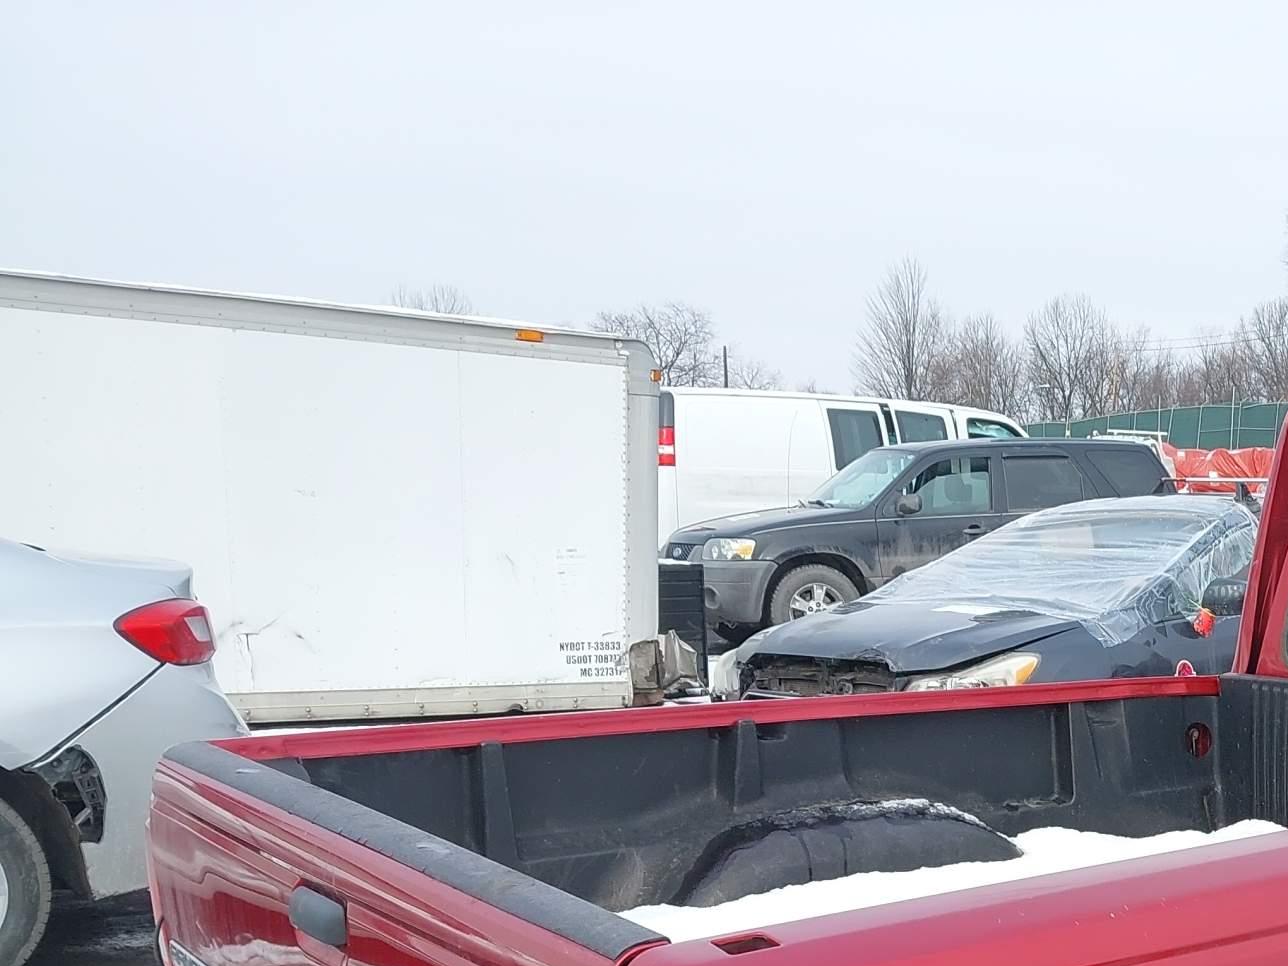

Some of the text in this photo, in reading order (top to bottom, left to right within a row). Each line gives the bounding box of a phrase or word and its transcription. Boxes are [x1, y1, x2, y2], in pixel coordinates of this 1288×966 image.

[559, 641, 585, 651] NYDOT
[566, 654, 592, 664] USDOT
[580, 667, 592, 677] MC
